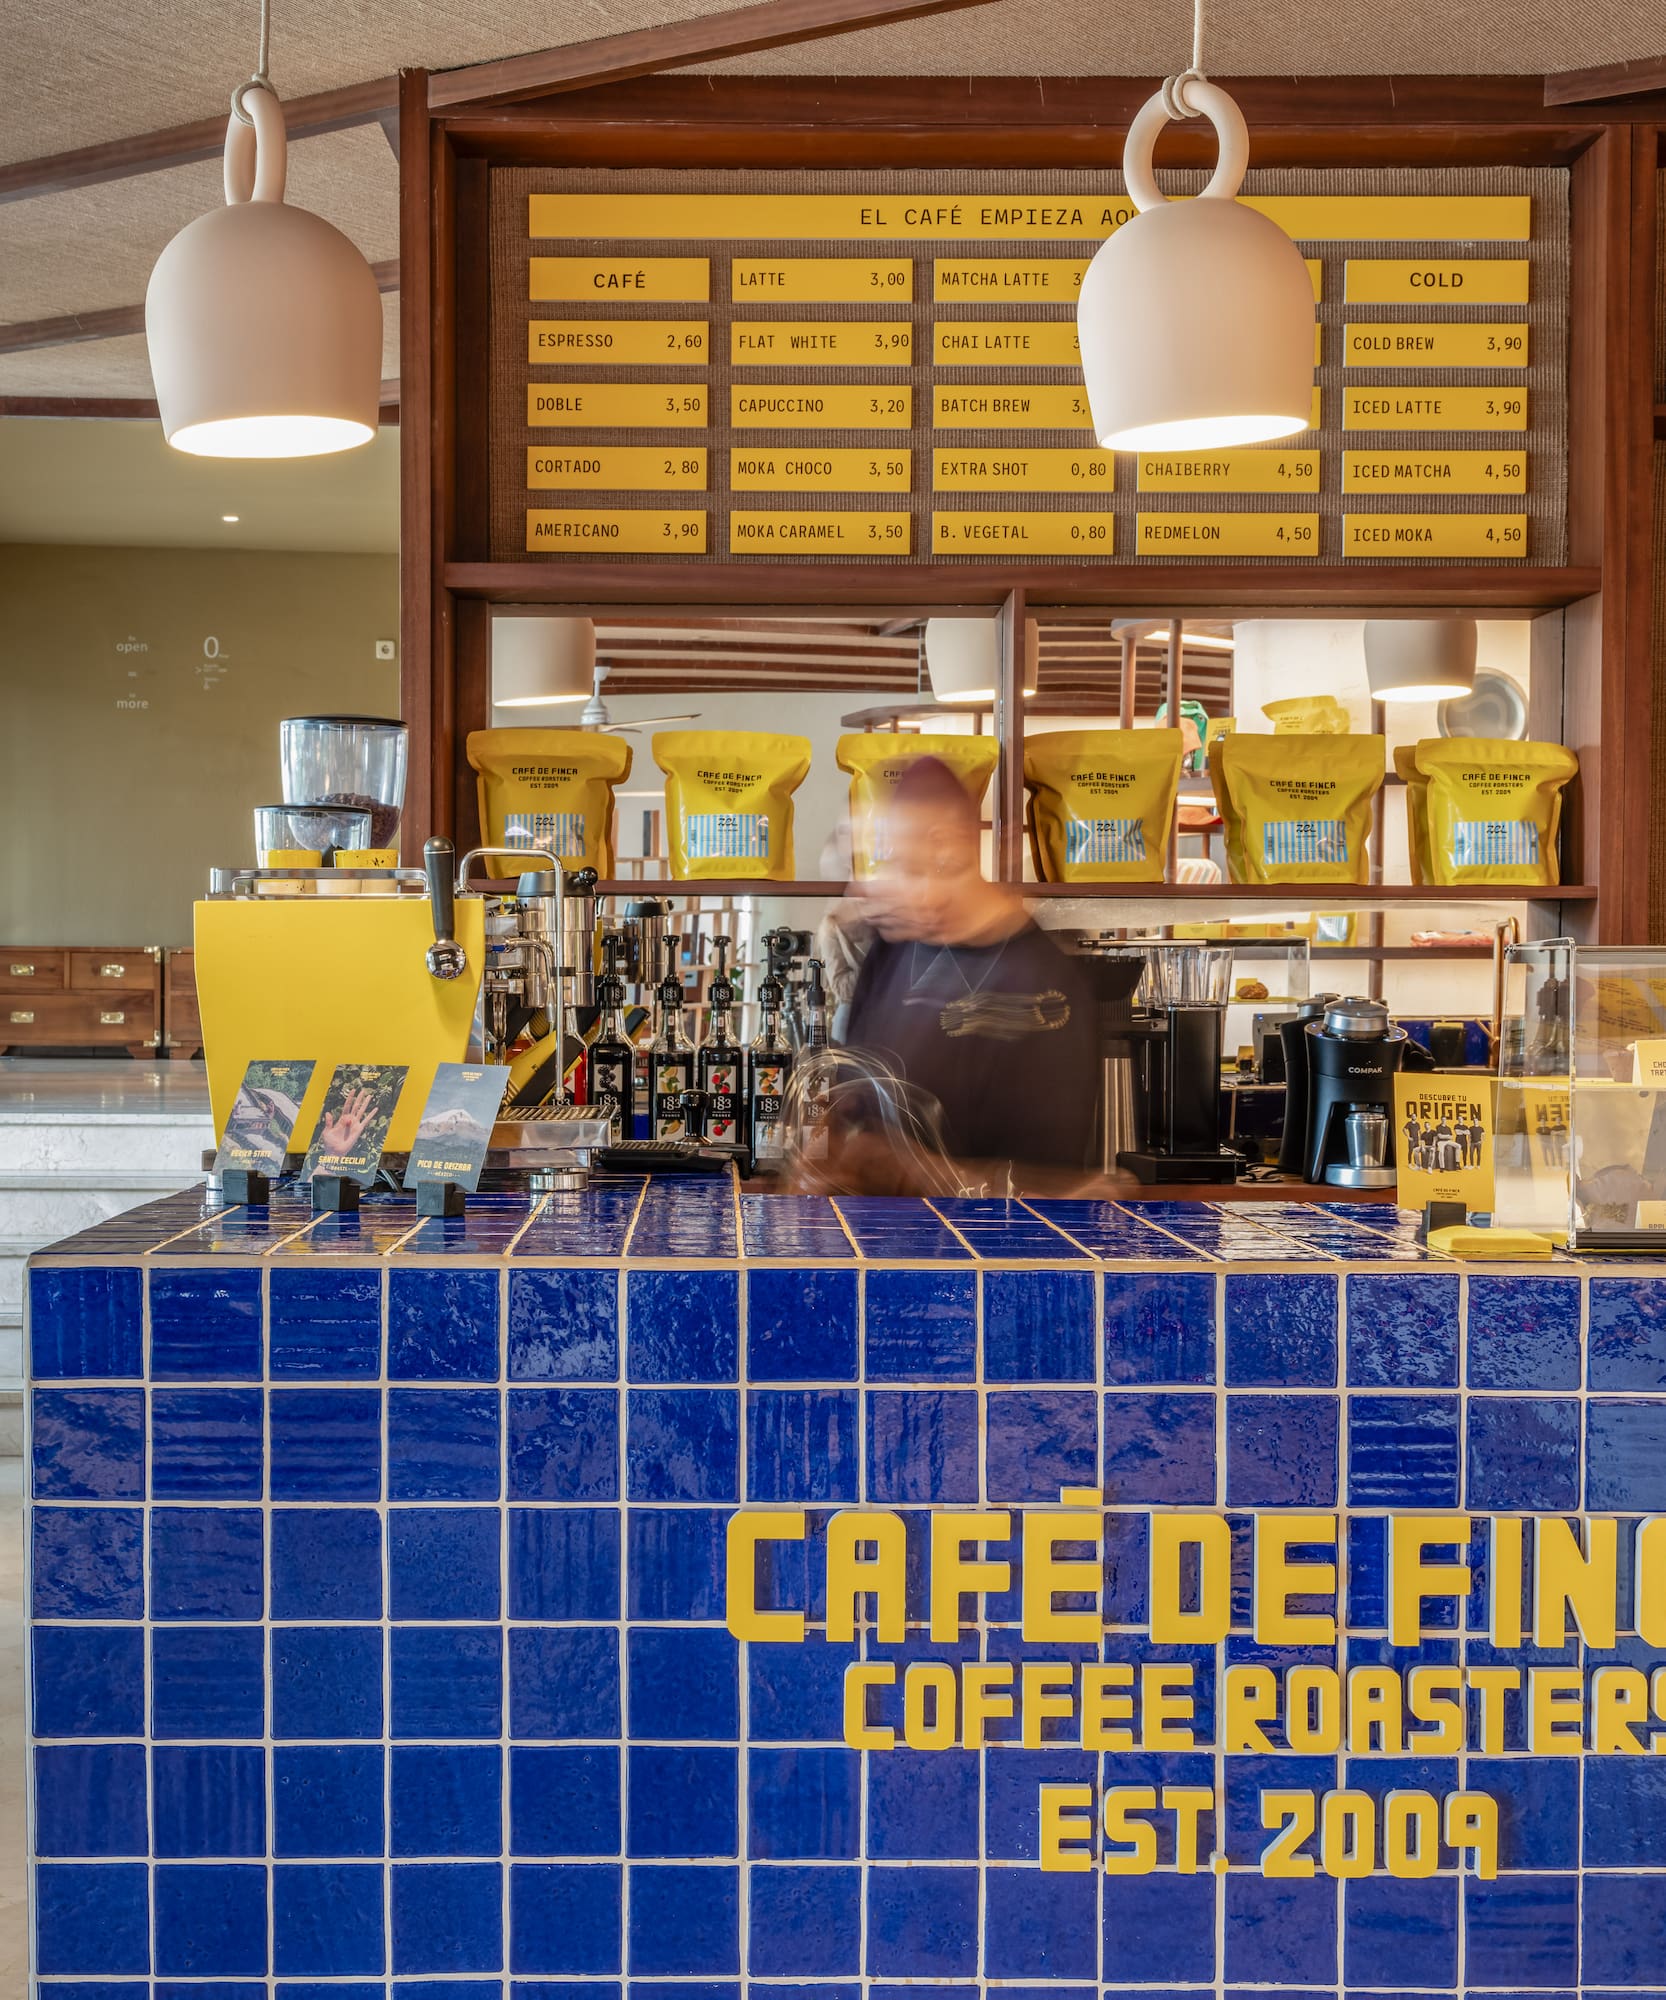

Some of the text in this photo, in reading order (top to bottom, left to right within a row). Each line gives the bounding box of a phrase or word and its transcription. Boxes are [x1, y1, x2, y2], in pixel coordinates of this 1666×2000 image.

[860, 208, 888, 225] EL
[904, 204, 962, 225] CAFÉ
[981, 208, 1083, 225] EMPIEZA
[593, 270, 646, 289] CAFÉ
[740, 272, 905, 287] LATTE 3,00
[941, 272, 1049, 287] MATCHA LATTE
[1409, 272, 1464, 288] COLD
[538, 333, 702, 349] ESPRESSO 2,60
[739, 334, 910, 350] FLAT WHITE 3,90
[941, 335, 1030, 349] CHAI LATTE
[1353, 336, 1522, 353] COLD BREW 3,90
[536, 397, 701, 414] DOBLE 3,50
[739, 399, 905, 415] CAPUCCINO 3,20
[941, 399, 1086, 414] BATCH BREW 3,
[1353, 400, 1521, 416] ICED LATTE 3,90
[535, 459, 699, 476] CORTADO 2,80
[737, 461, 904, 477] MOKA CHOCO 3,50
[941, 462, 1106, 478] EXTRA SHOT 0,80
[1145, 463, 1313, 479] CHAIBERRY 4,50
[1353, 464, 1521, 480] ICED MATCHA 4,50
[535, 523, 699, 539] AMERICANO 3,90
[737, 524, 903, 541] MOKA CARAMEL 3,50
[940, 525, 1106, 540] B. VEGETAL 0,80
[1145, 526, 1312, 543] REDMELON 4,50
[1353, 528, 1521, 544] ICED MOKA 4,50
[115, 641, 149, 655] open
[115, 699, 150, 710] more
[1348, 1066, 1383, 1074] COMPAK
[1419, 1093, 1456, 1102] DESCUBRE
[1406, 1101, 1482, 1121] ORIGEN
[726, 1487, 1102, 1643] CAFÉ
[1150, 1511, 1336, 1646] DE
[843, 1662, 1194, 1751] COFFEE
[1039, 1783, 1498, 1880] EST. 2009
